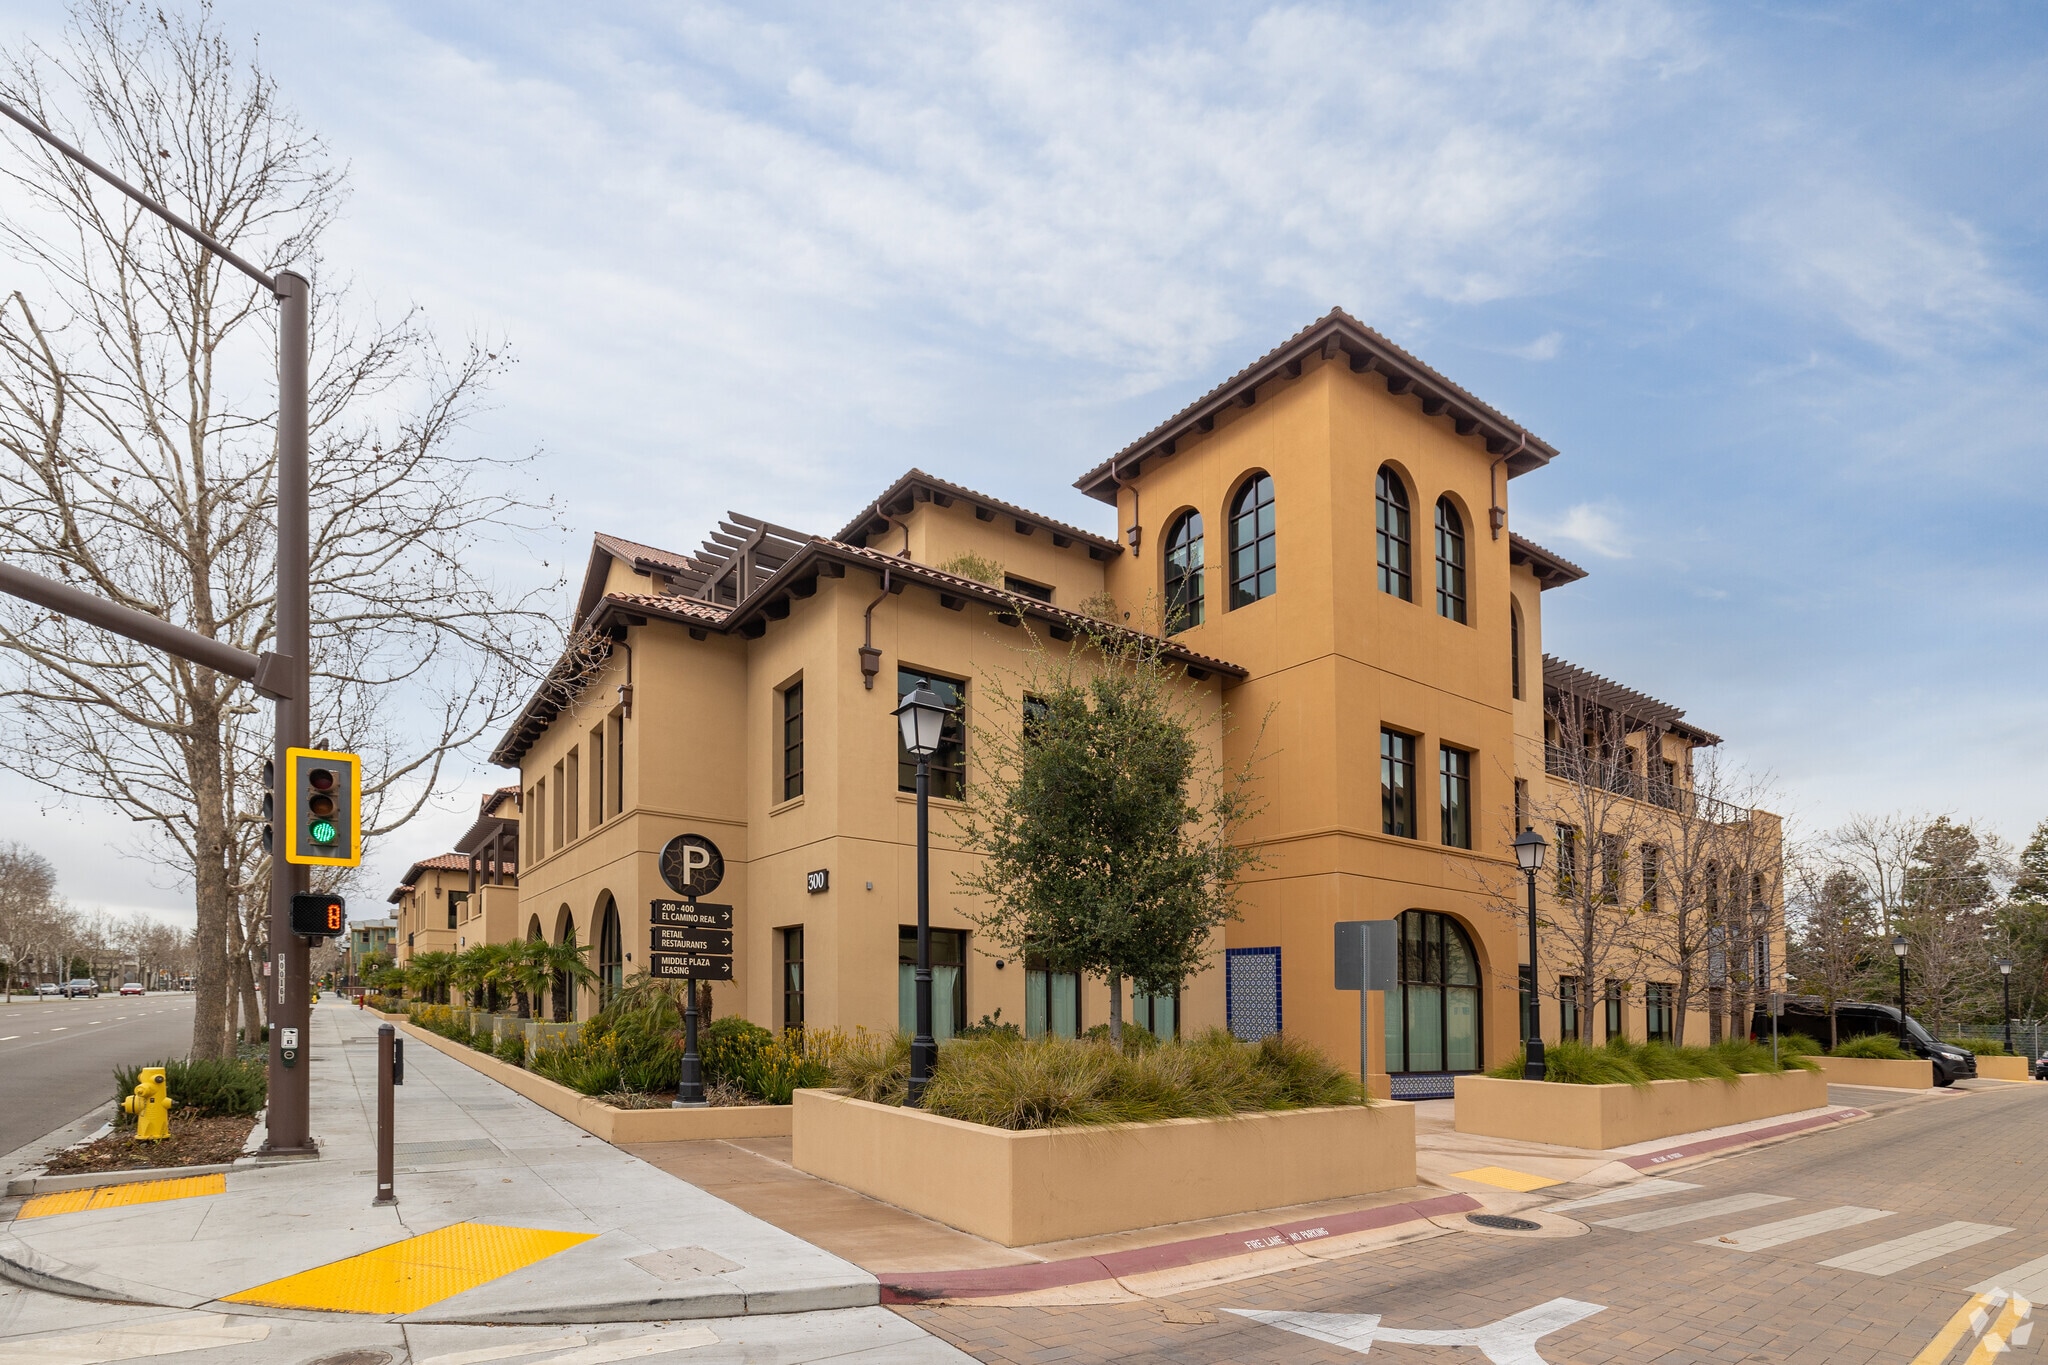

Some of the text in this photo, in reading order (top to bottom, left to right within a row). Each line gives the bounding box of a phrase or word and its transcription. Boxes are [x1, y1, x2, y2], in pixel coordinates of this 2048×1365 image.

[683, 845, 710, 885] P
[808, 872, 824, 890] 300
[662, 903, 675, 911] 200
[680, 904, 694, 913] 400
[327, 904, 340, 929] 8
[662, 912, 716, 924] EL CAMINO REAL
[662, 930, 684, 939] RETAIL
[662, 939, 708, 950] RESTAURANTS
[662, 957, 710, 967] MIDDLE PLAZA
[661, 966, 690, 975] LEASING
[1244, 1239, 1265, 1250] FIRE
[1263, 1235, 1285, 1247] LANE
[1289, 1232, 1302, 1242] NO
[1300, 1227, 1329, 1240] PARKING
